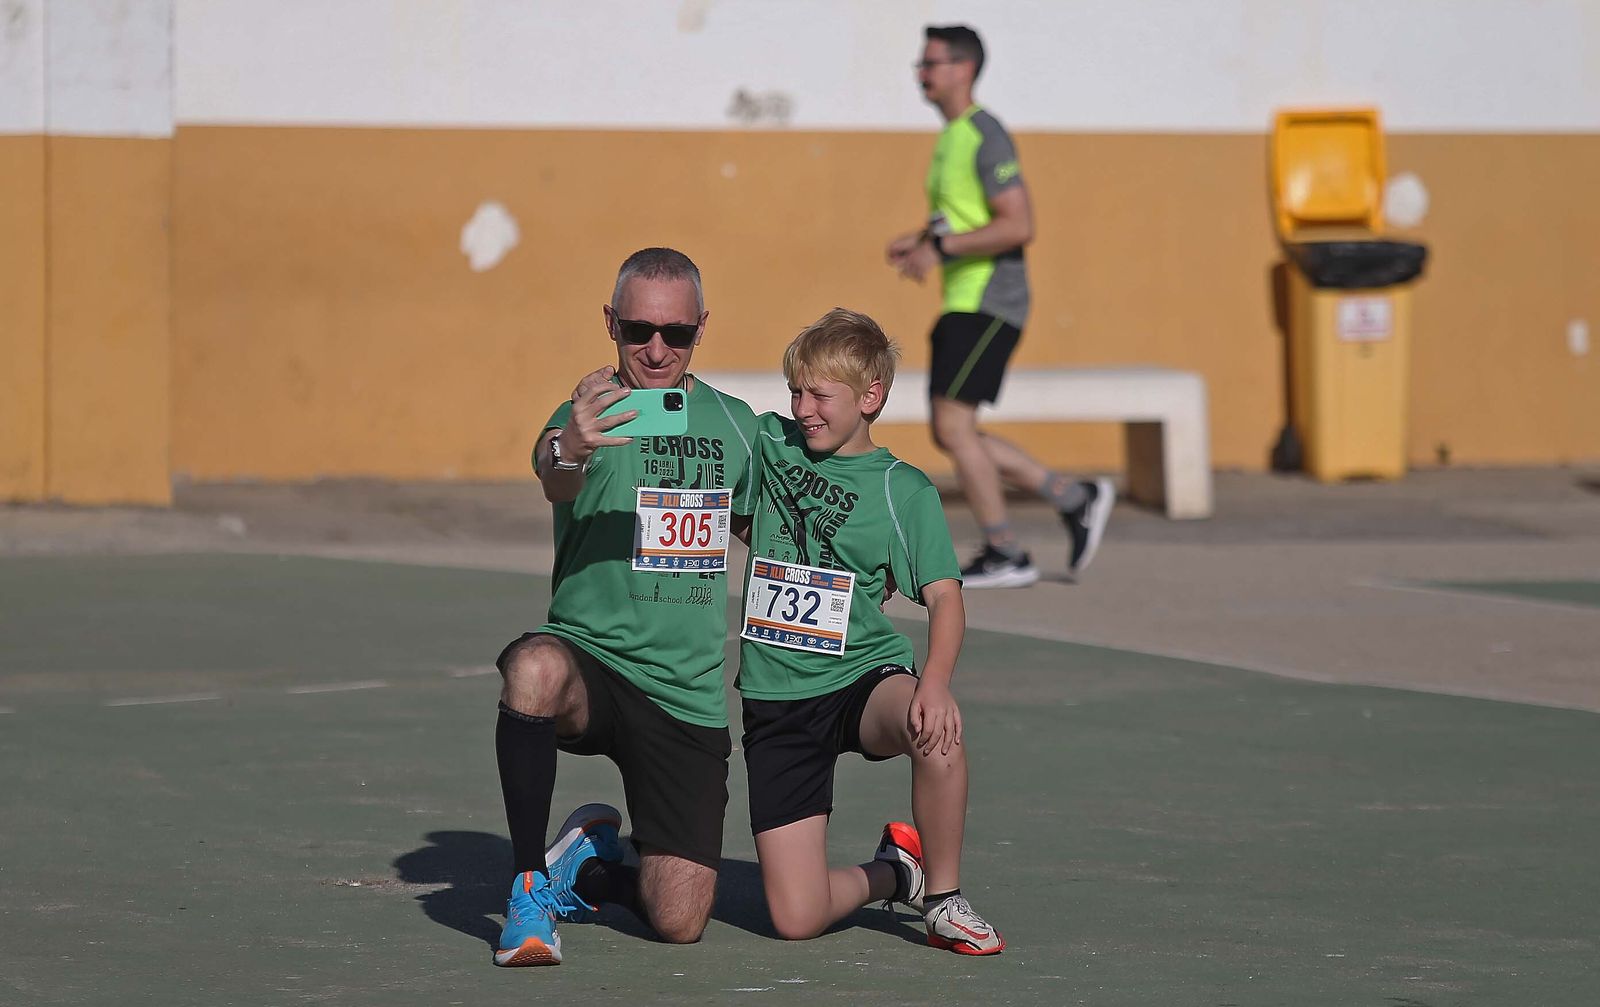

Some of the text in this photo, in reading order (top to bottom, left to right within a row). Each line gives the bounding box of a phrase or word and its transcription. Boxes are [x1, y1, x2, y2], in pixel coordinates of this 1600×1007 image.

[653, 436, 724, 461] CROSS
[643, 459, 658, 475] 16
[659, 468, 674, 477] 2023
[785, 465, 859, 512] CROSS
[680, 493, 704, 508] CROSS
[658, 512, 712, 548] 305
[785, 567, 811, 585] CROSS
[629, 591, 682, 604] london school
[766, 583, 822, 626] 732
